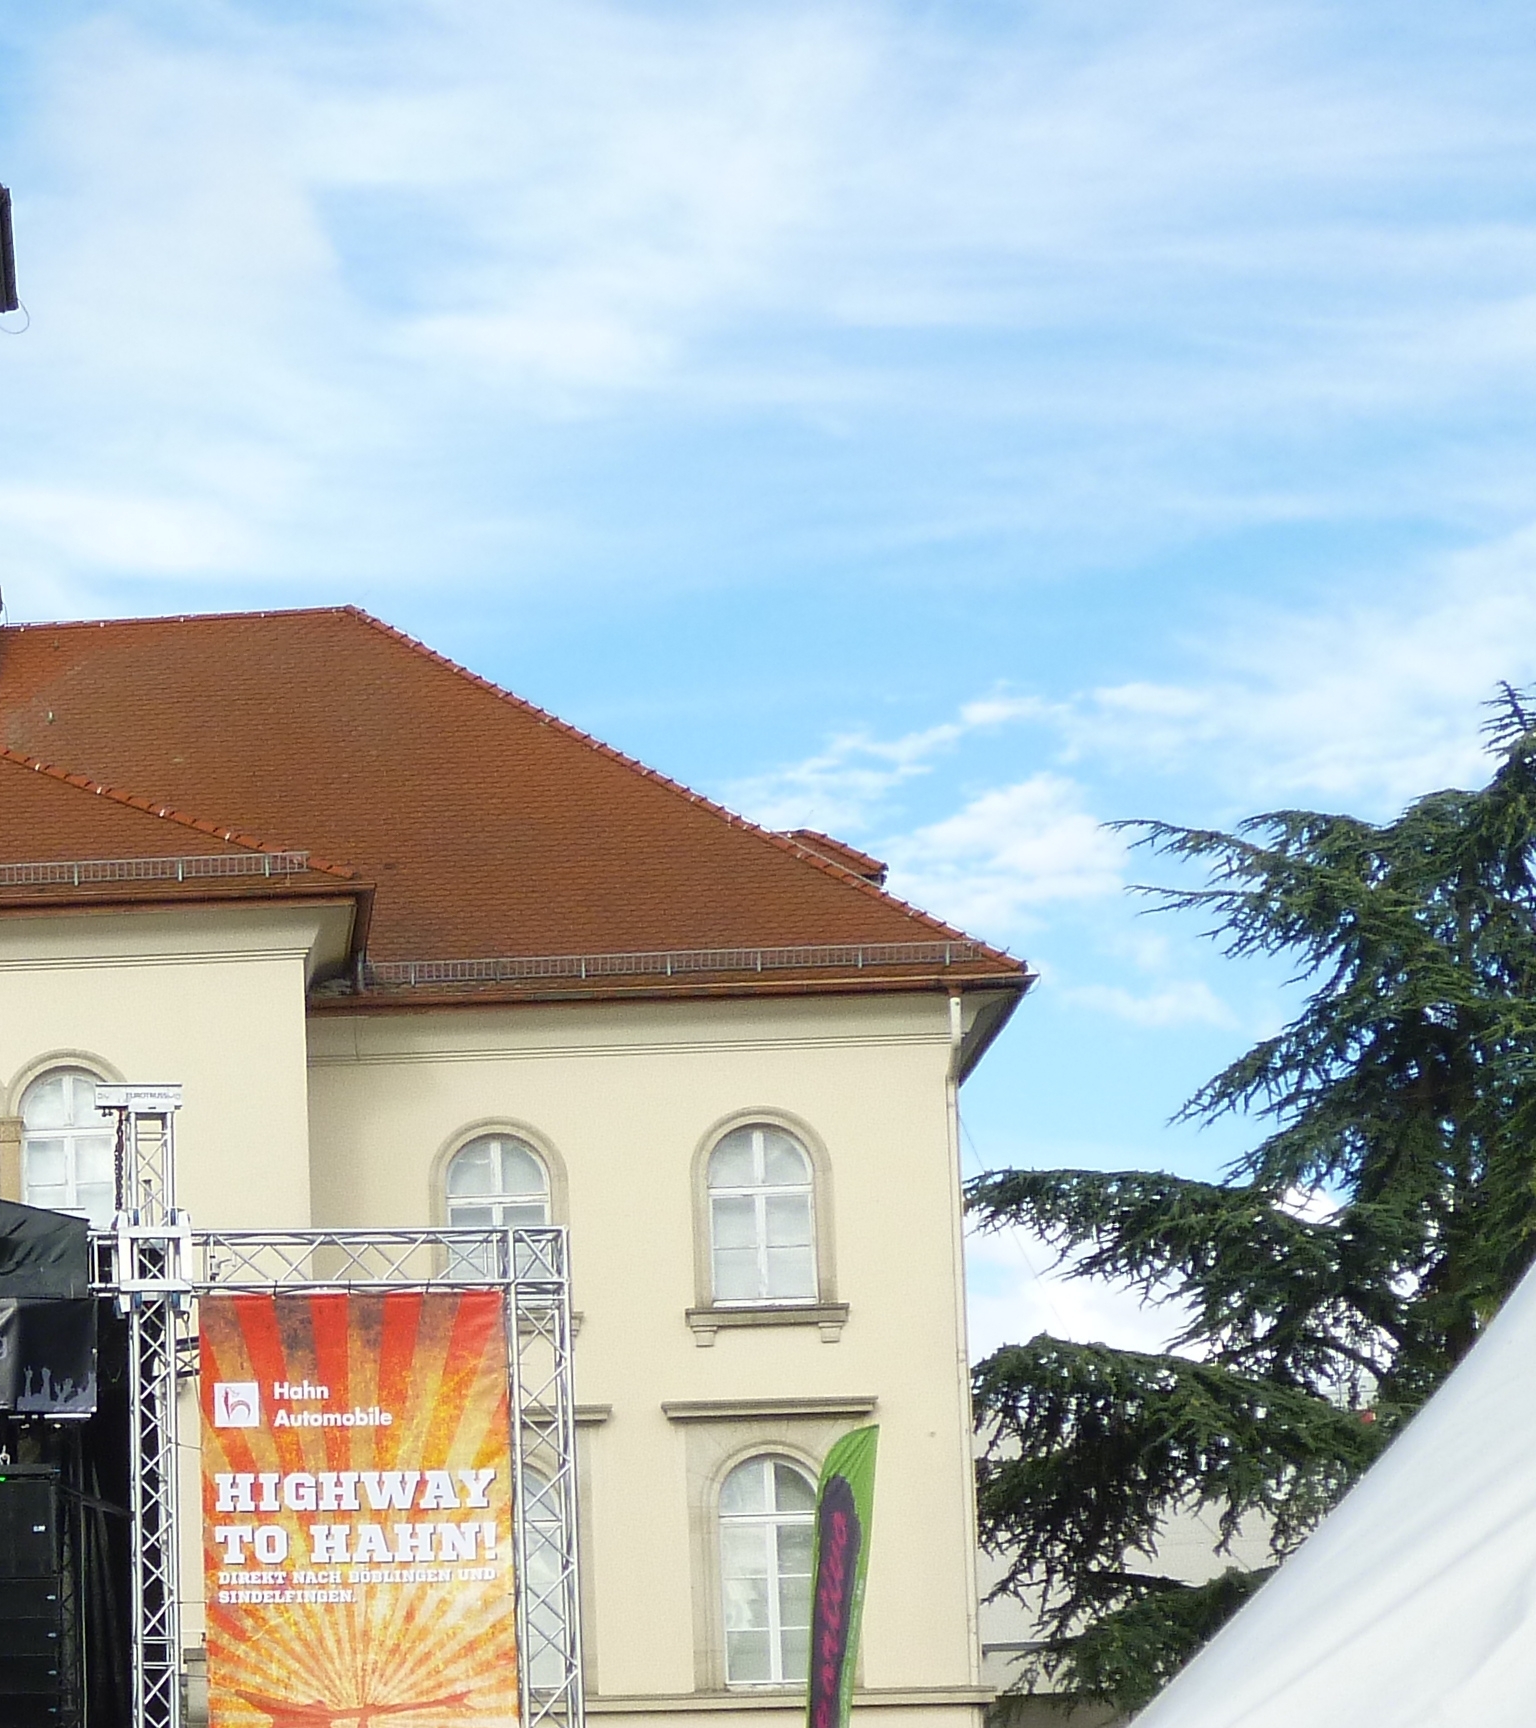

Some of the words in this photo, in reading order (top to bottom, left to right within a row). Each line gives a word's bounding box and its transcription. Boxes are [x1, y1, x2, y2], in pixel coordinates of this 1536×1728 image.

[273, 1381, 329, 1400] Hahn
[273, 1407, 393, 1427] Automobile
[214, 1470, 496, 1512] HIGHWAY
[214, 1526, 288, 1565] TO
[310, 1522, 497, 1563] HAHN!
[218, 1571, 287, 1585] DIREKT
[292, 1571, 342, 1585] NACH
[348, 1569, 452, 1585] BÖBLINGEN
[458, 1568, 496, 1582] UND
